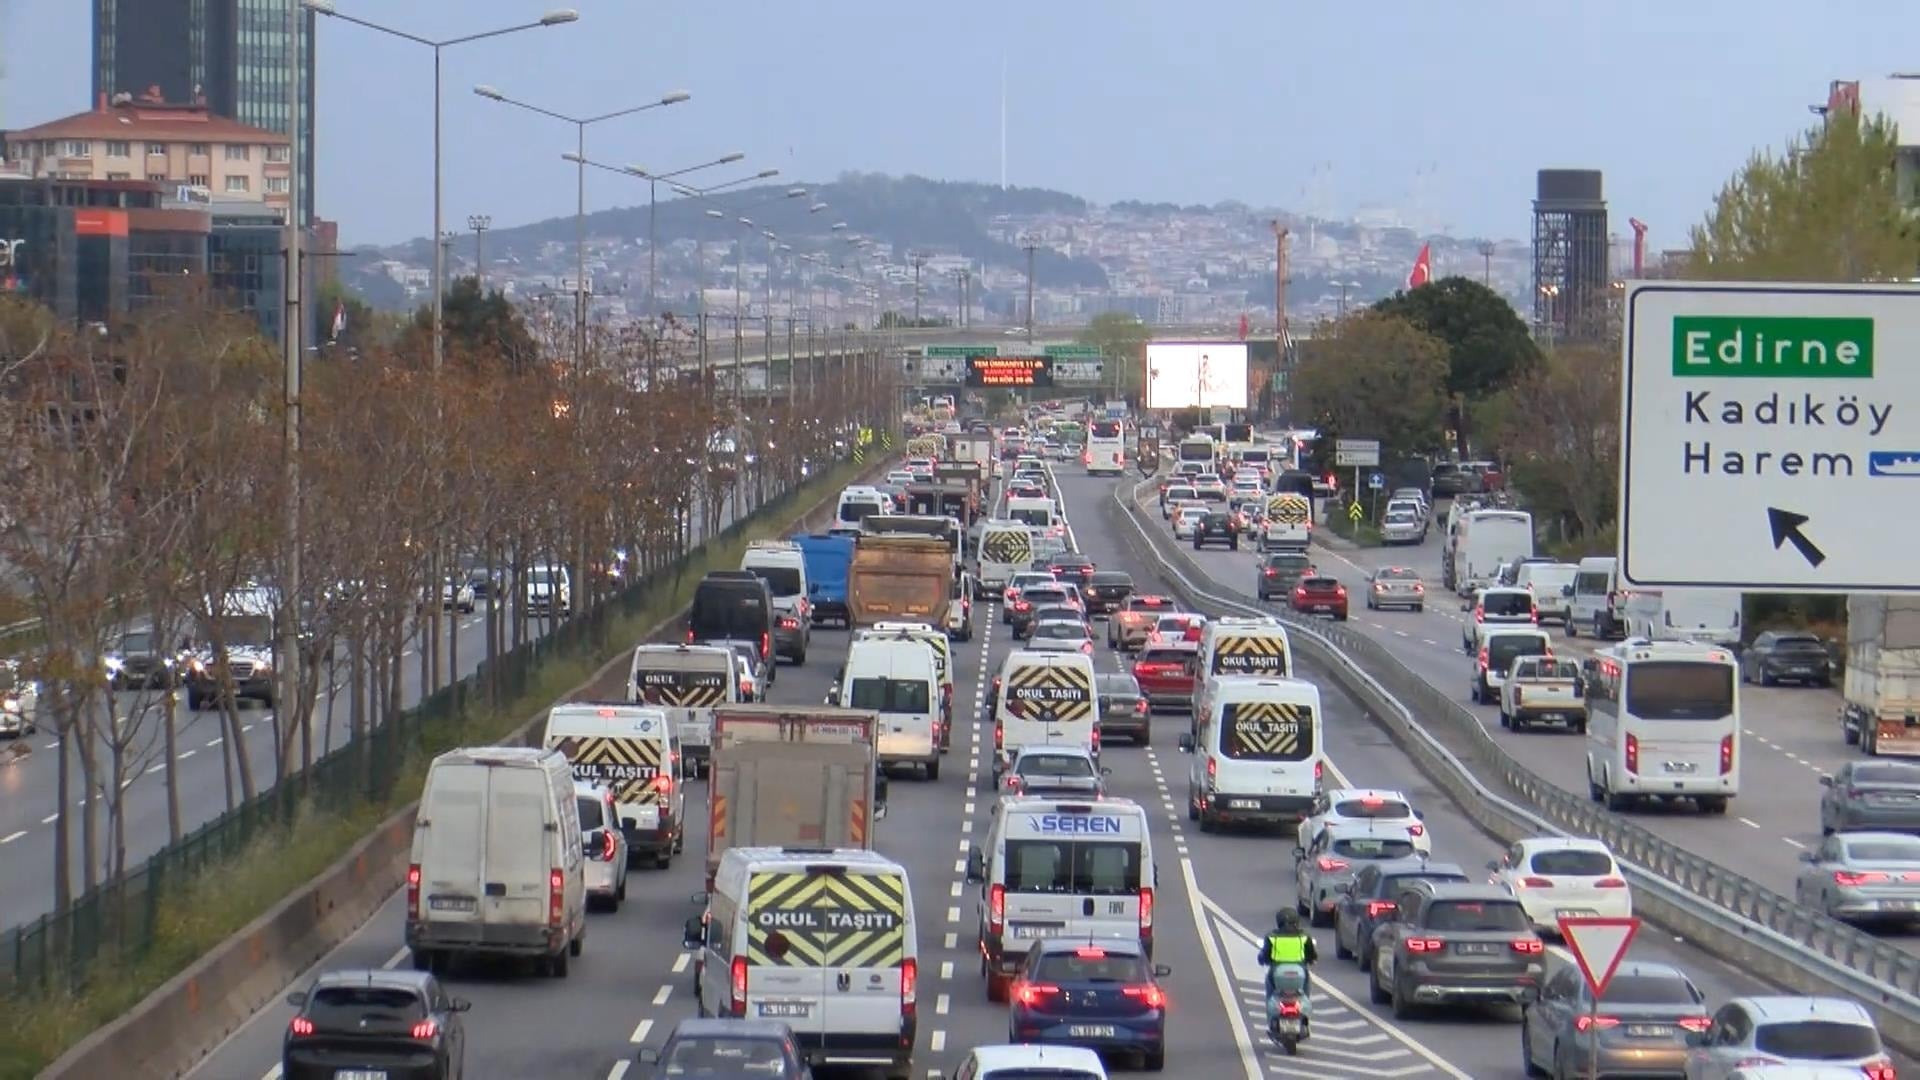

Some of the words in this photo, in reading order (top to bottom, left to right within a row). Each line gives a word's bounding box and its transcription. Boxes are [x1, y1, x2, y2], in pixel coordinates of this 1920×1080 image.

[1686, 326, 1860, 364] Edirne
[1685, 391, 1893, 436] Kadıköy
[1684, 442, 1853, 476] Harem
[1222, 656, 1248, 667] OKUL
[645, 674, 675, 685] OKUL
[1016, 688, 1045, 698] OKUL
[1236, 721, 1262, 733] OKUL
[571, 764, 601, 777] KUL
[605, 765, 657, 781] TAŞITI
[1042, 815, 1120, 833] SEREN
[1108, 900, 1125, 915] FIAT
[759, 912, 817, 927] OKUL
[828, 912, 893, 930] TAŞITI
